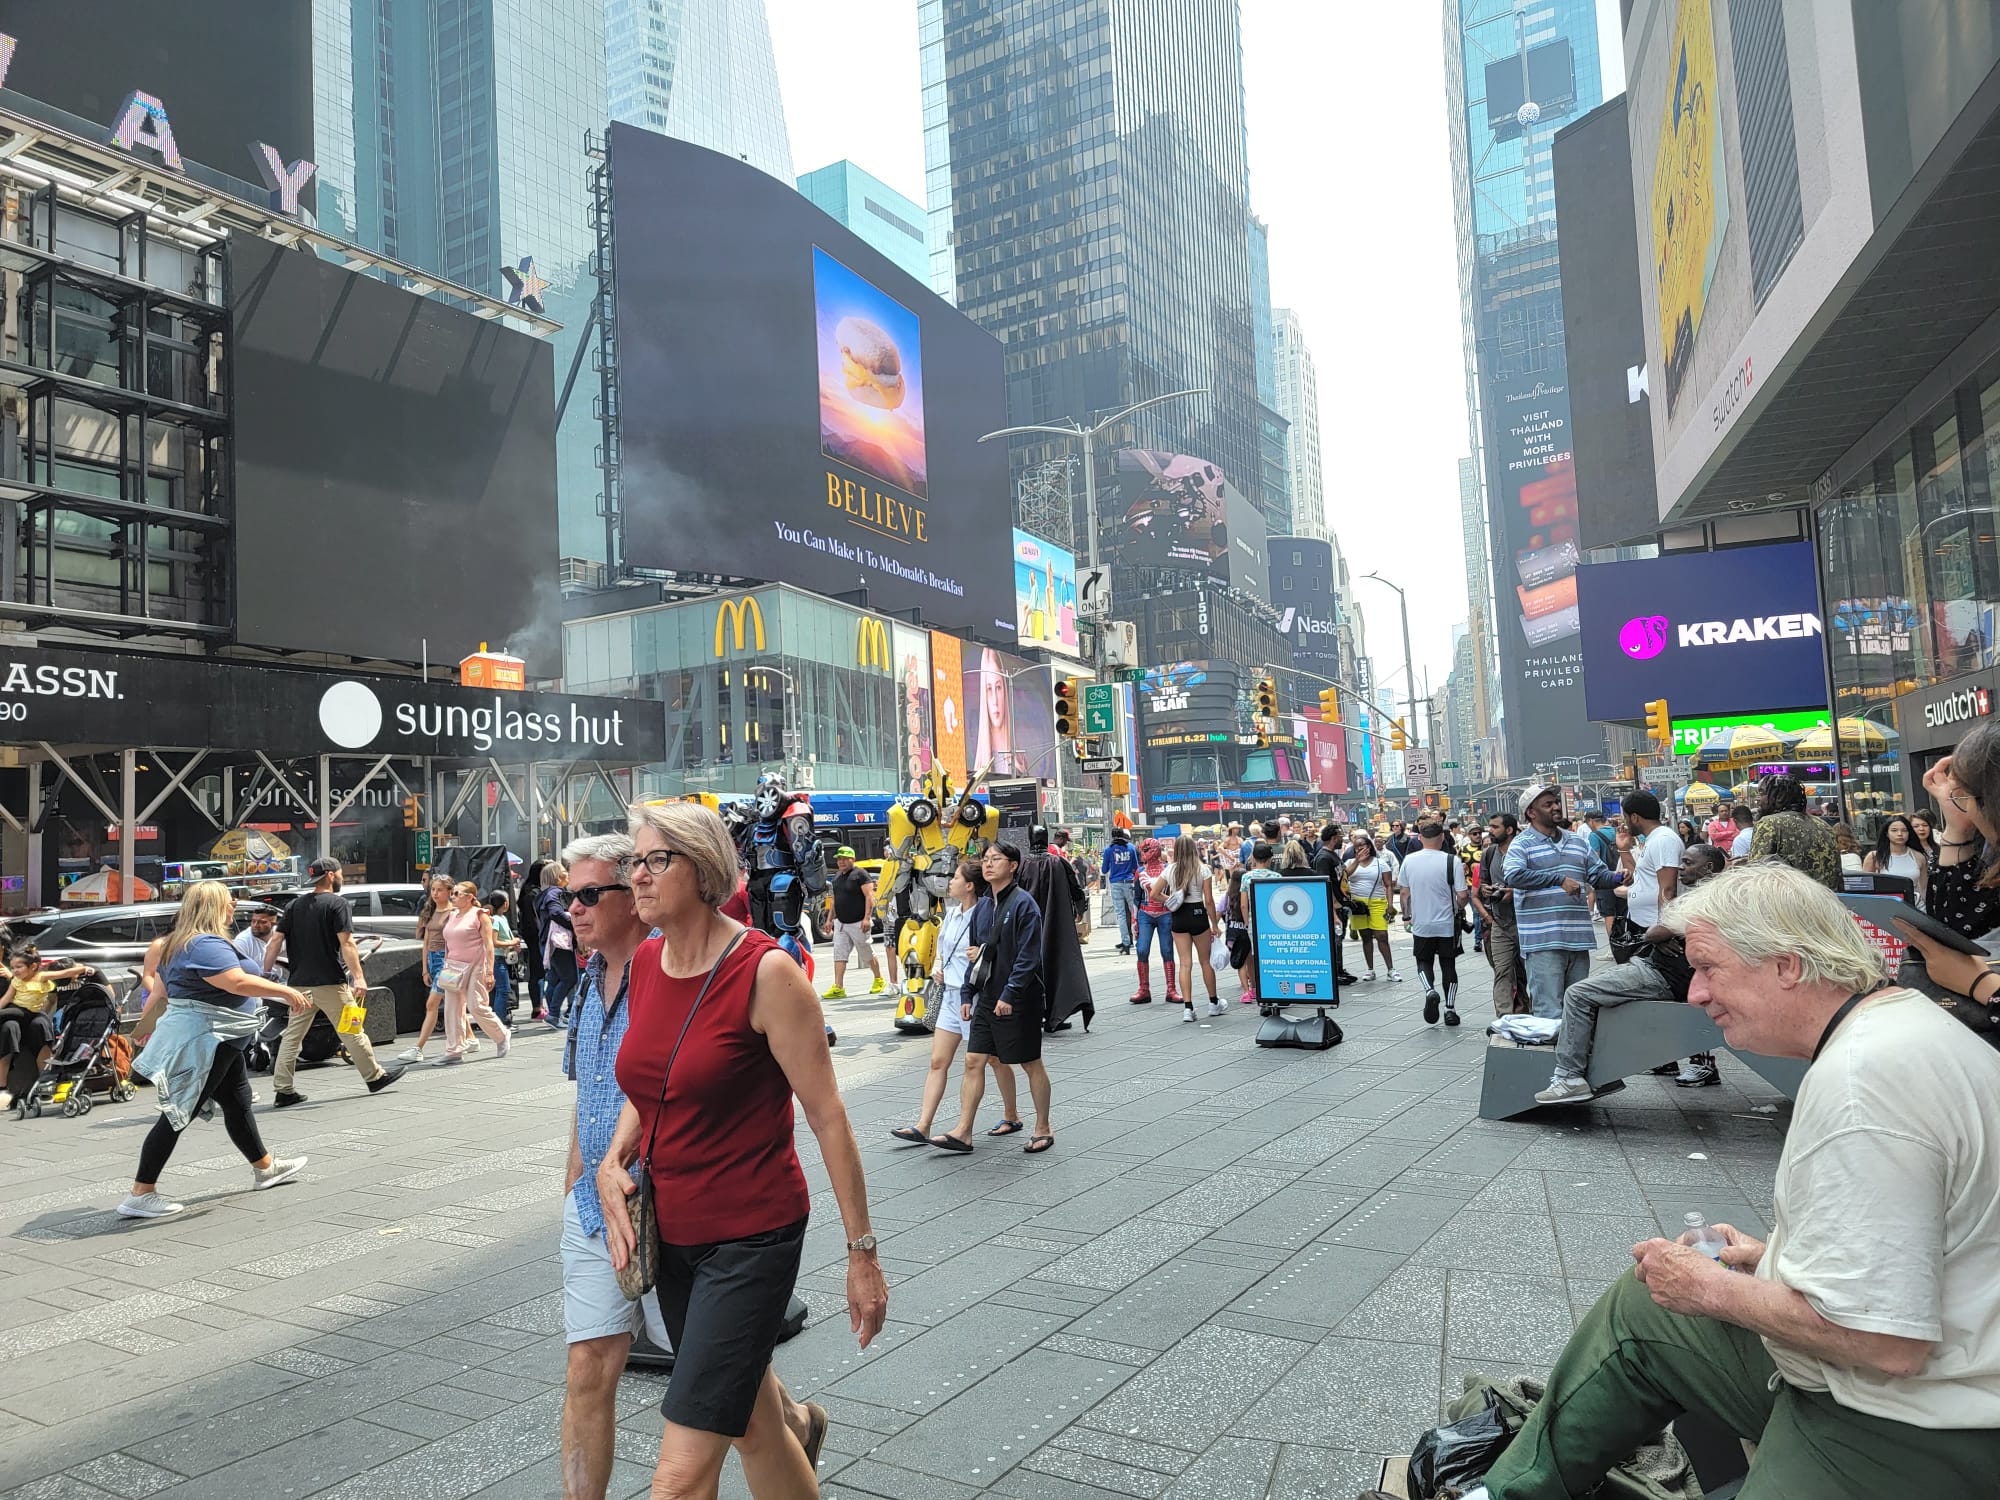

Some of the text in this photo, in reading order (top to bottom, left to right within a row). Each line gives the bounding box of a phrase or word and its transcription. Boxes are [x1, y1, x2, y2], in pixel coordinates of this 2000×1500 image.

[1712, 366, 1747, 433] swatch
[1522, 410, 1550, 422] VISIT
[1510, 419, 1564, 436] THAILAND
[1524, 433, 1551, 445] WITH
[1523, 443, 1554, 457] MORE
[1508, 452, 1571, 470] PRIVILEGES
[826, 471, 928, 542] BELIEVE
[774, 520, 964, 598] You Can Make It To McDonald's Breakfast
[1081, 599, 1106, 612] ONLY
[1677, 612, 1822, 648] KRAKEN
[1524, 653, 1583, 667] THAILAND
[1126, 670, 1136, 680] 45
[1524, 665, 1584, 679] PRIVILEG
[1, 663, 124, 700] ASSN.
[1541, 678, 1574, 689] CARD
[1161, 685, 1179, 696] THE
[1150, 693, 1191, 713] BEAR
[1924, 686, 1978, 728] swatch
[395, 696, 624, 751] sunglass hut
[1152, 736, 1183, 746] STREAMING
[1184, 734, 1206, 743] 6.22
[1210, 733, 1228, 742] hulu
[1733, 746, 1780, 758] SABRETT
[1086, 762, 1100, 770] ONE
[1408, 764, 1427, 776] 25
[361, 783, 402, 808] hut
[1166, 804, 1182, 812] Slam
[1182, 802, 1197, 812] title
[1255, 801, 1276, 810] hiring
